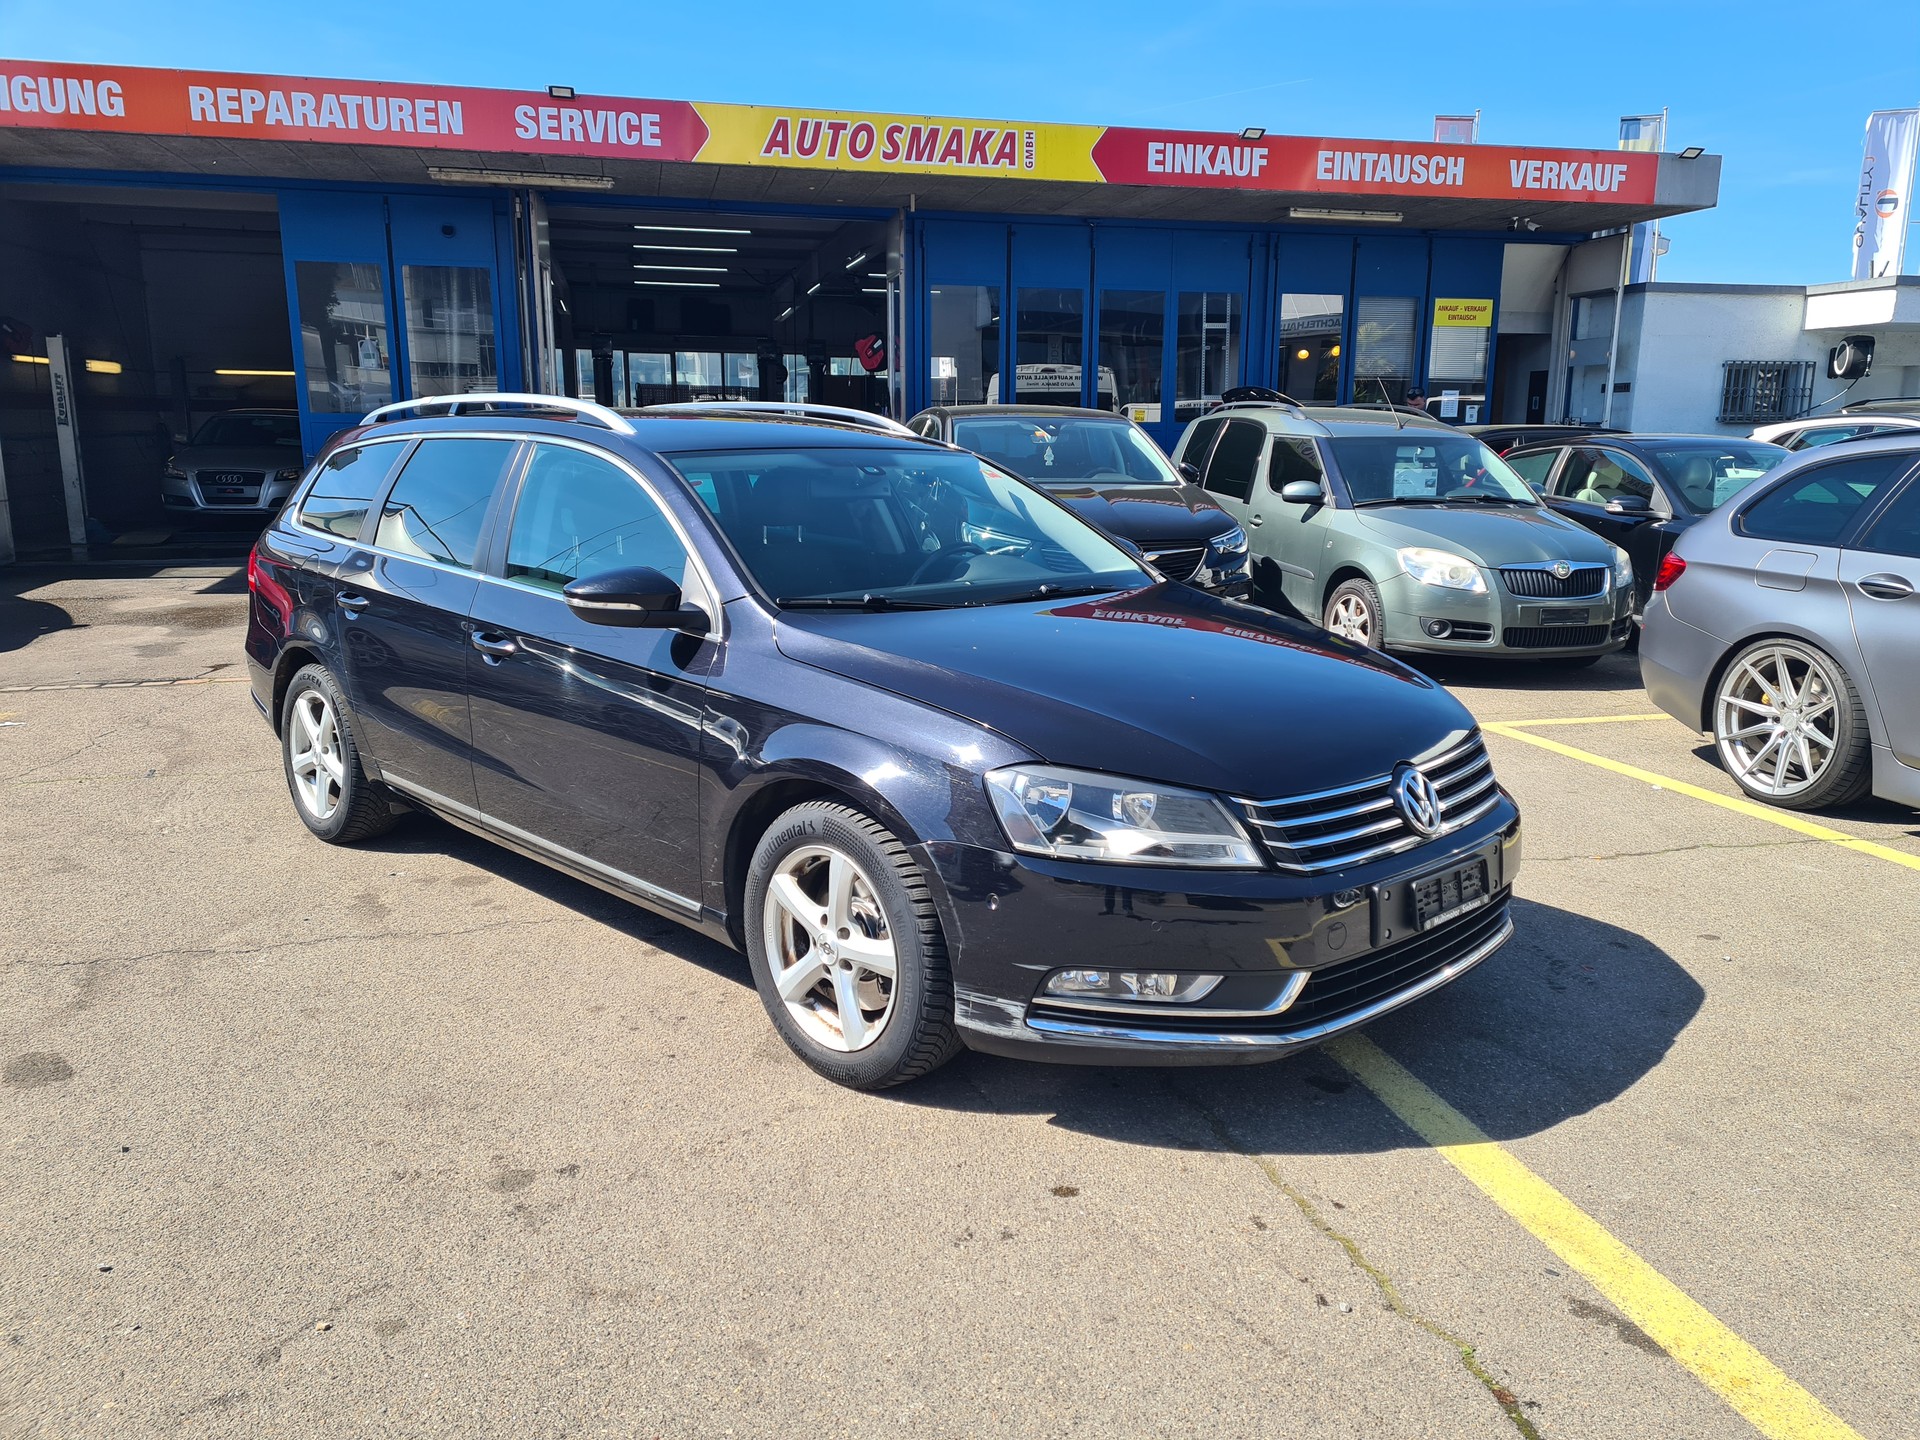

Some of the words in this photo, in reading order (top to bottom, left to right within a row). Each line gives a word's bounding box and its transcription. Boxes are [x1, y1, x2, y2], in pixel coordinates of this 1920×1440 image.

[188, 85, 465, 136] REPARATUREN
[514, 104, 662, 147] SERVICE
[761, 117, 876, 161] AUTO
[880, 123, 1018, 169] SMAKA
[1025, 130, 1035, 169] GMBH
[1147, 141, 1269, 177] EINKAUF
[1316, 150, 1465, 186] EINTAUSCH
[1509, 159, 1628, 192] VERKAUF
[298, 673, 322, 688] NEXEN
[758, 819, 808, 871] Continental
